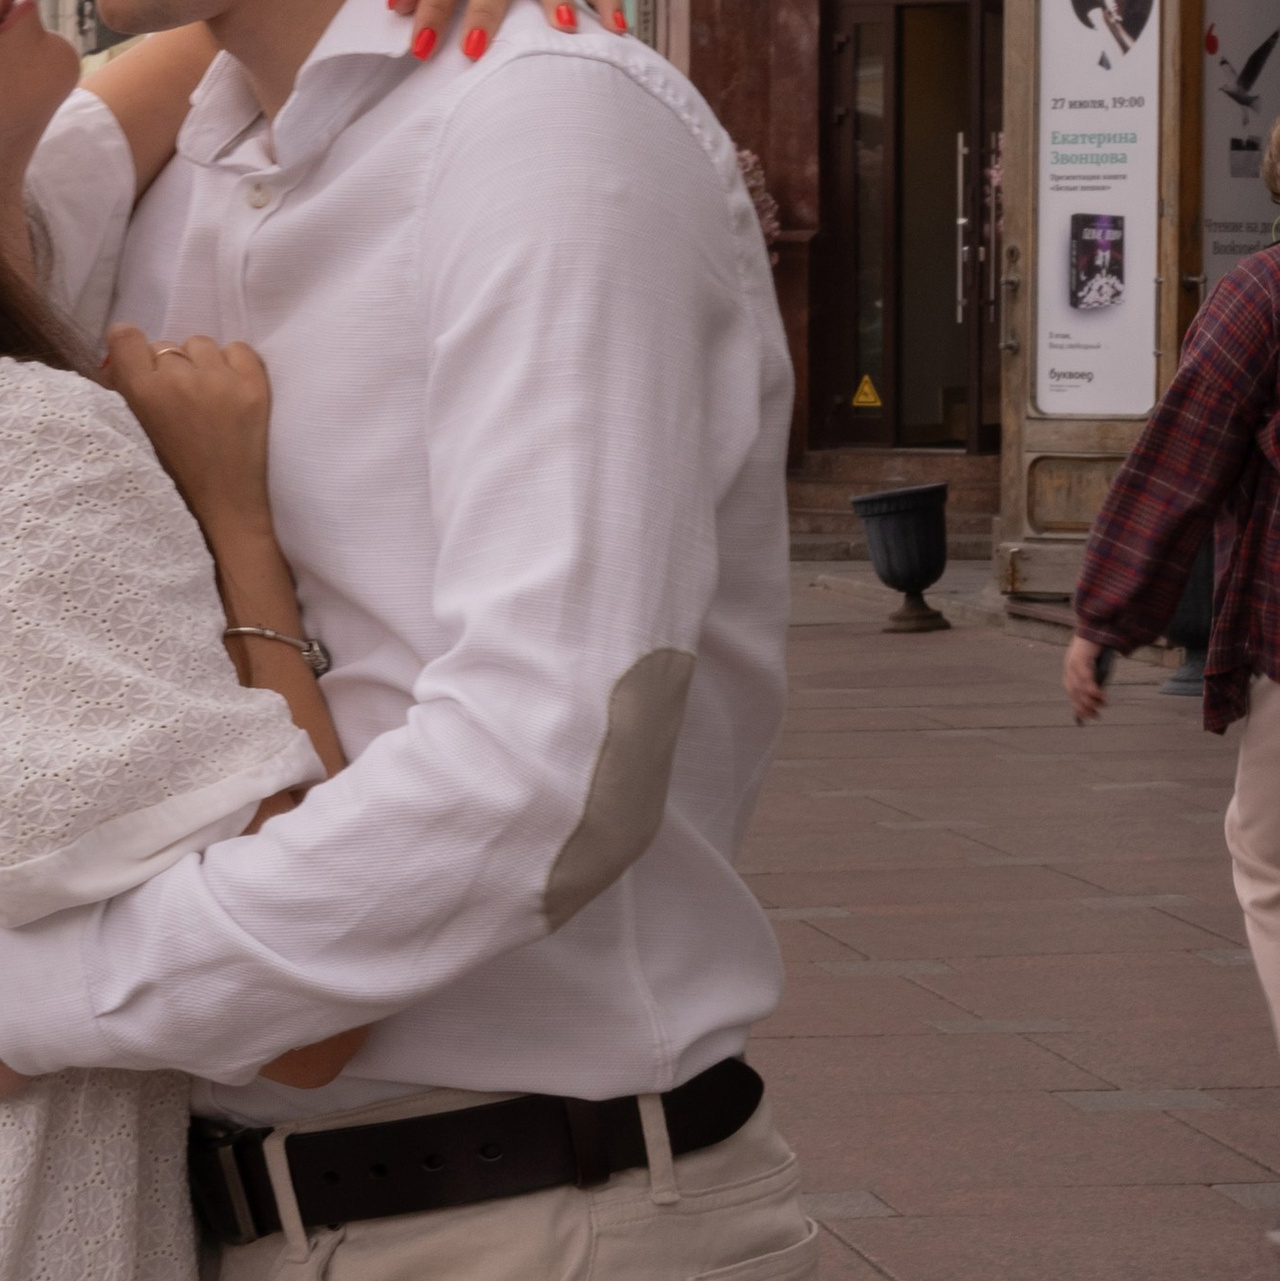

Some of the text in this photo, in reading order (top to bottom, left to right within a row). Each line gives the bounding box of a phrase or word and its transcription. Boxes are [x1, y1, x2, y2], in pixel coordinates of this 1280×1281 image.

[1051, 96, 1145, 111] 27 июля, 19:00
[1050, 131, 1138, 148] Екатерина
[1050, 151, 1128, 166] Звонцова
